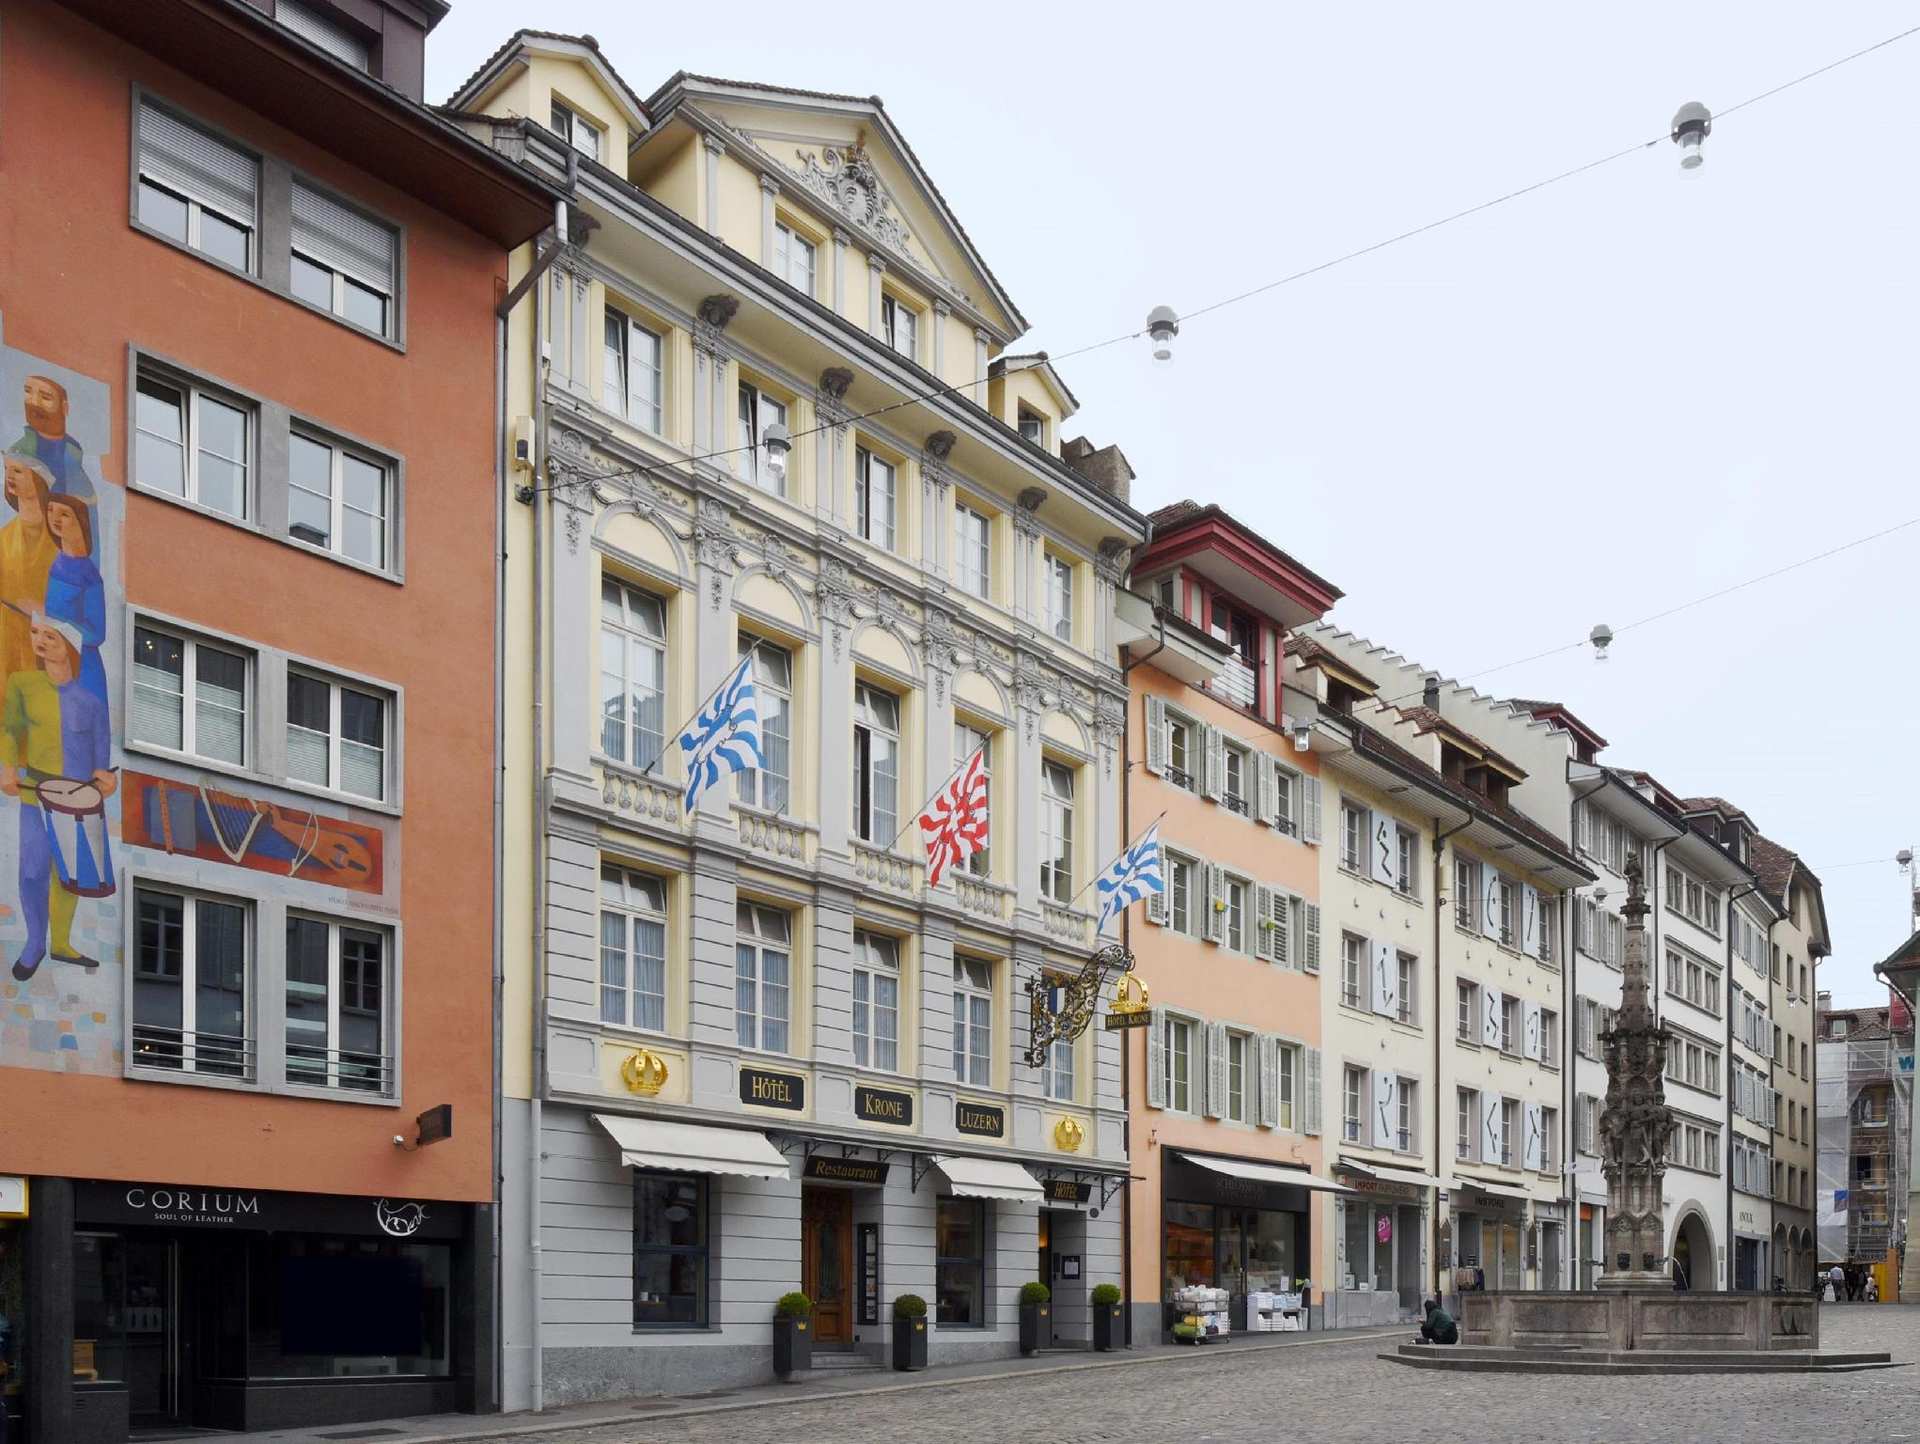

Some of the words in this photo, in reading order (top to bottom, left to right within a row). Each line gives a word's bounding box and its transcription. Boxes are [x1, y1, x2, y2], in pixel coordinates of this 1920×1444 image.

[864, 1093, 903, 1118] KRONE
[960, 1107, 1000, 1130] LUZERN
[816, 1160, 880, 1180] Restaurant
[126, 1189, 260, 1214] CORIUM
[154, 1213, 177, 1221] SOUL
[195, 1215, 234, 1223] LEATHER
